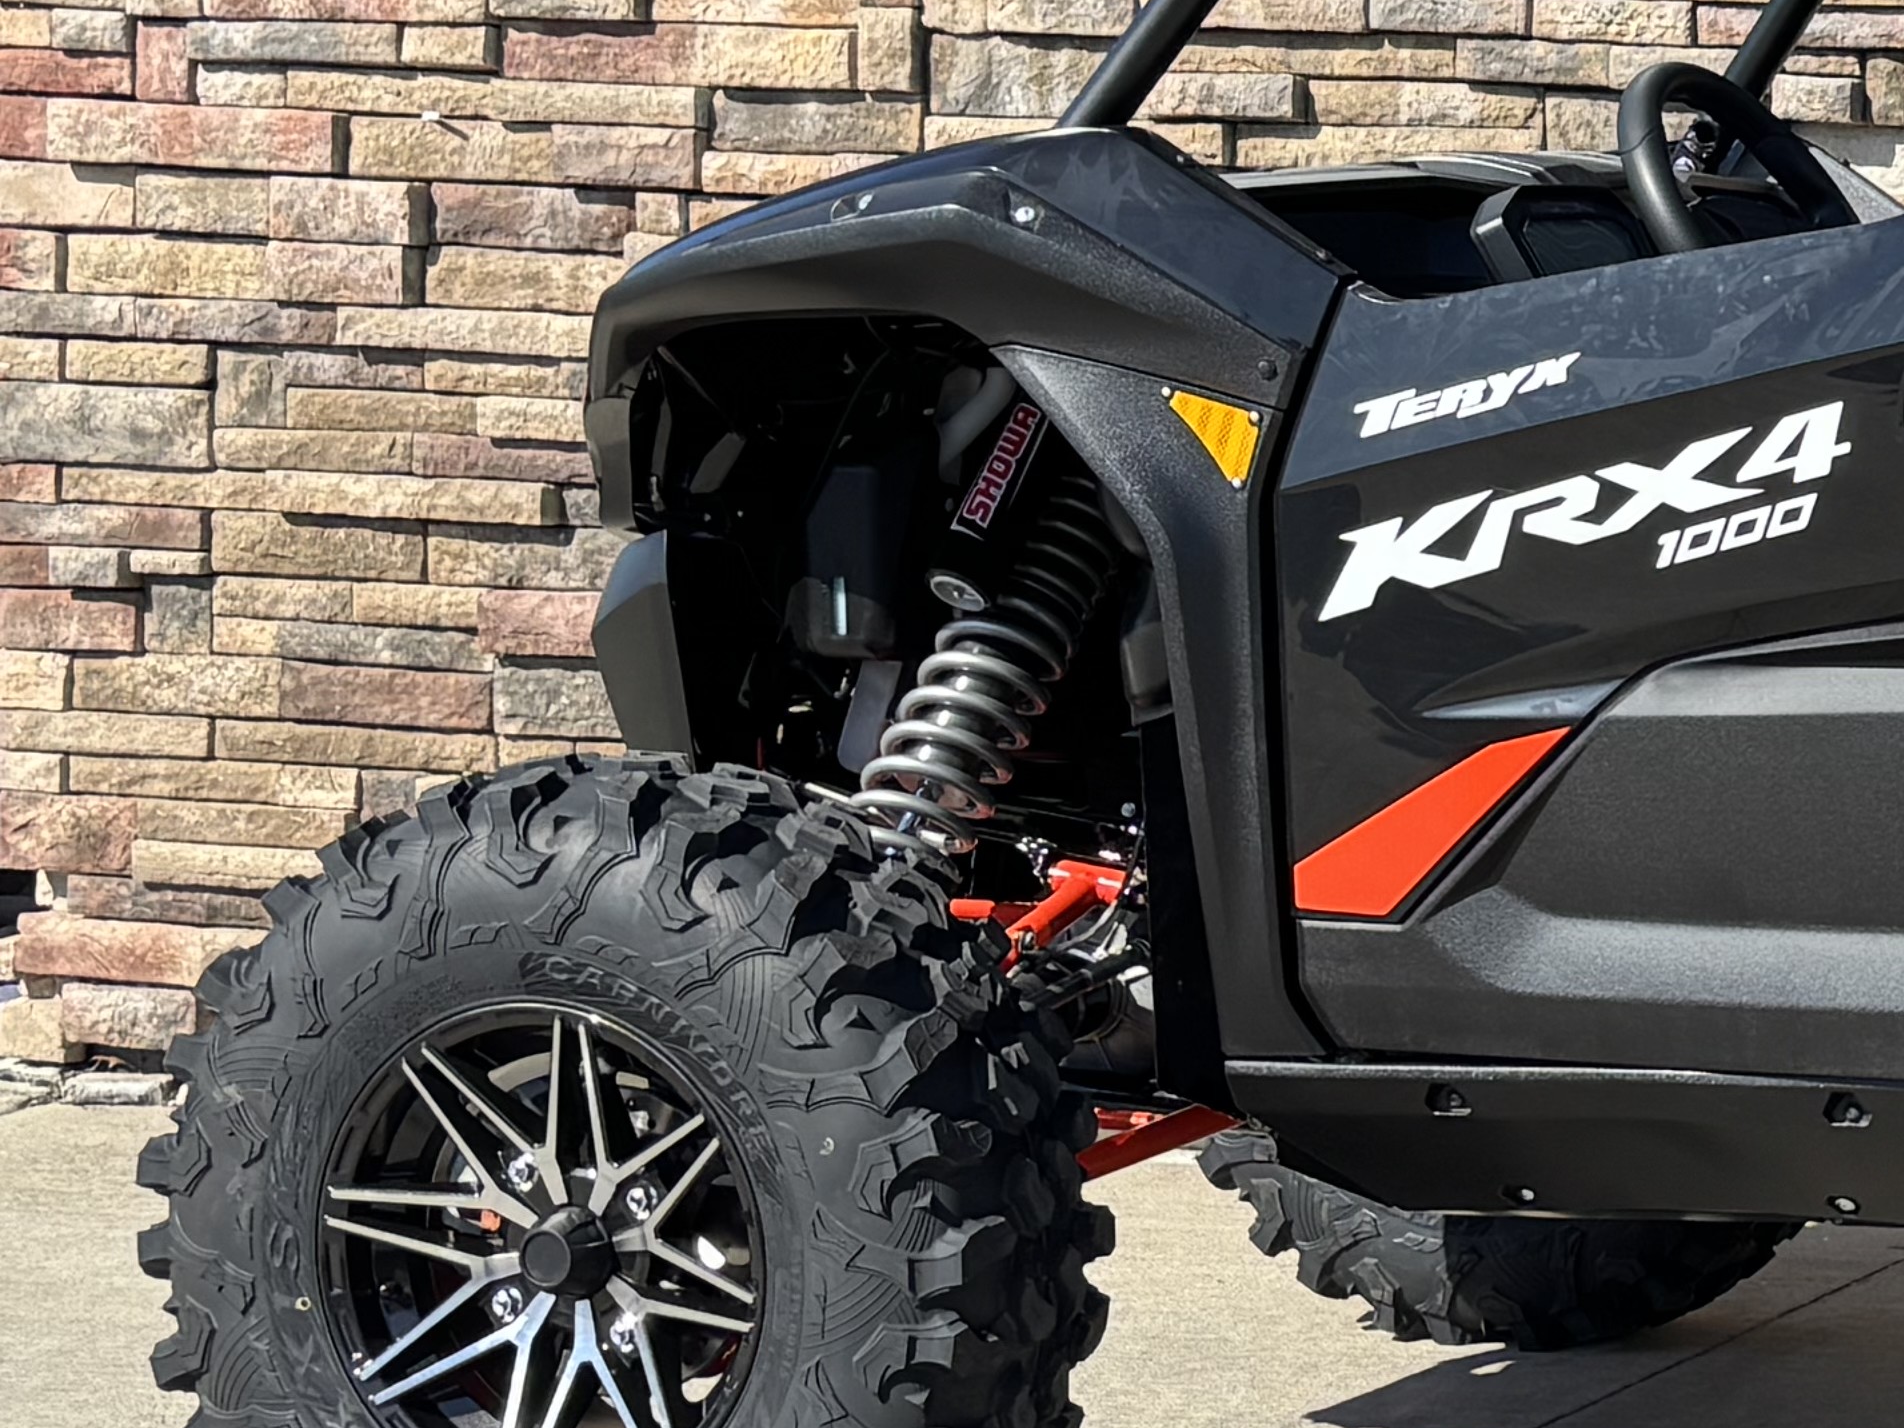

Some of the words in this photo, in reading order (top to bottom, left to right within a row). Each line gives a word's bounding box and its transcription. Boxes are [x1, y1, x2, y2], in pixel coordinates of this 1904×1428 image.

[1353, 352, 1581, 438] TERYX
[963, 402, 1041, 529] SHOWA
[1655, 492, 1818, 569] 1000
